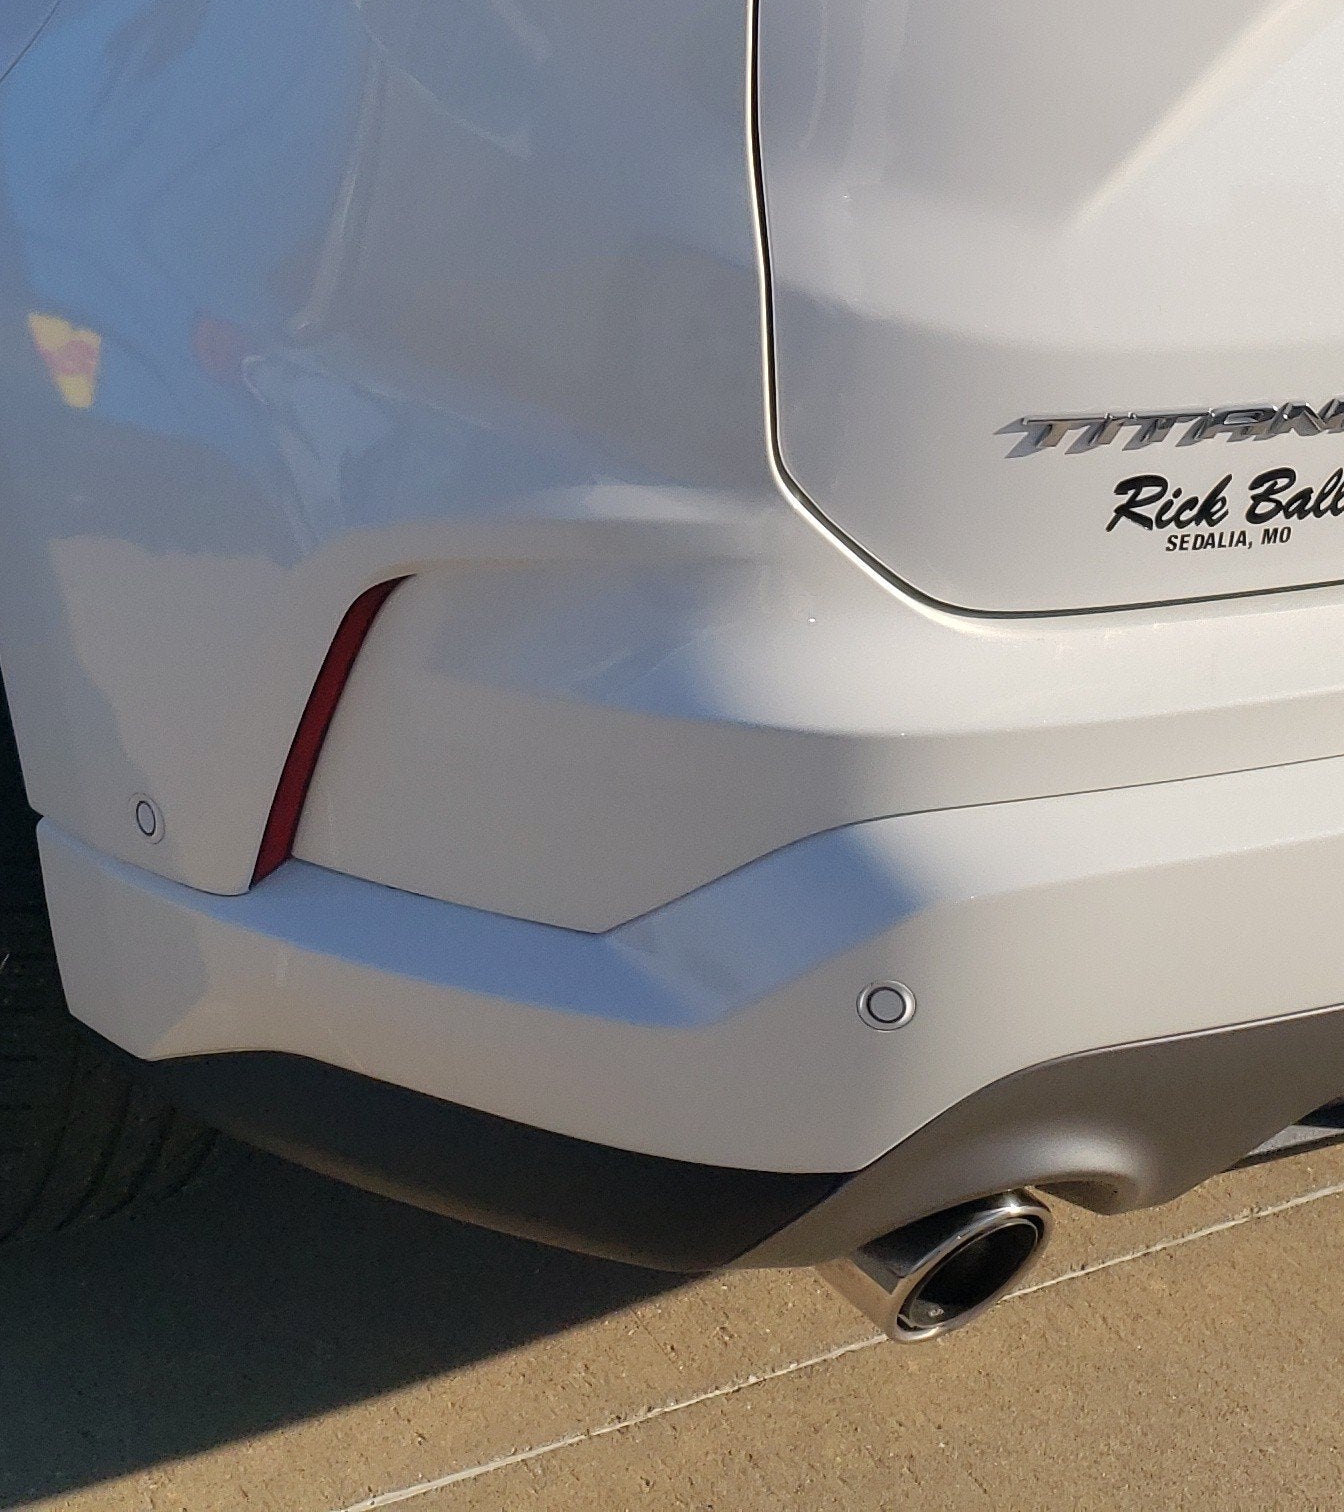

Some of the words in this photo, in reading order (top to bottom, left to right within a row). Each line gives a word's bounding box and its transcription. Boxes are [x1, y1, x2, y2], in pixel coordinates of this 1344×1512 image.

[1106, 474, 1232, 532] Rick
[1165, 529, 1253, 551] SEDALIA,
[1261, 526, 1291, 546] MO
